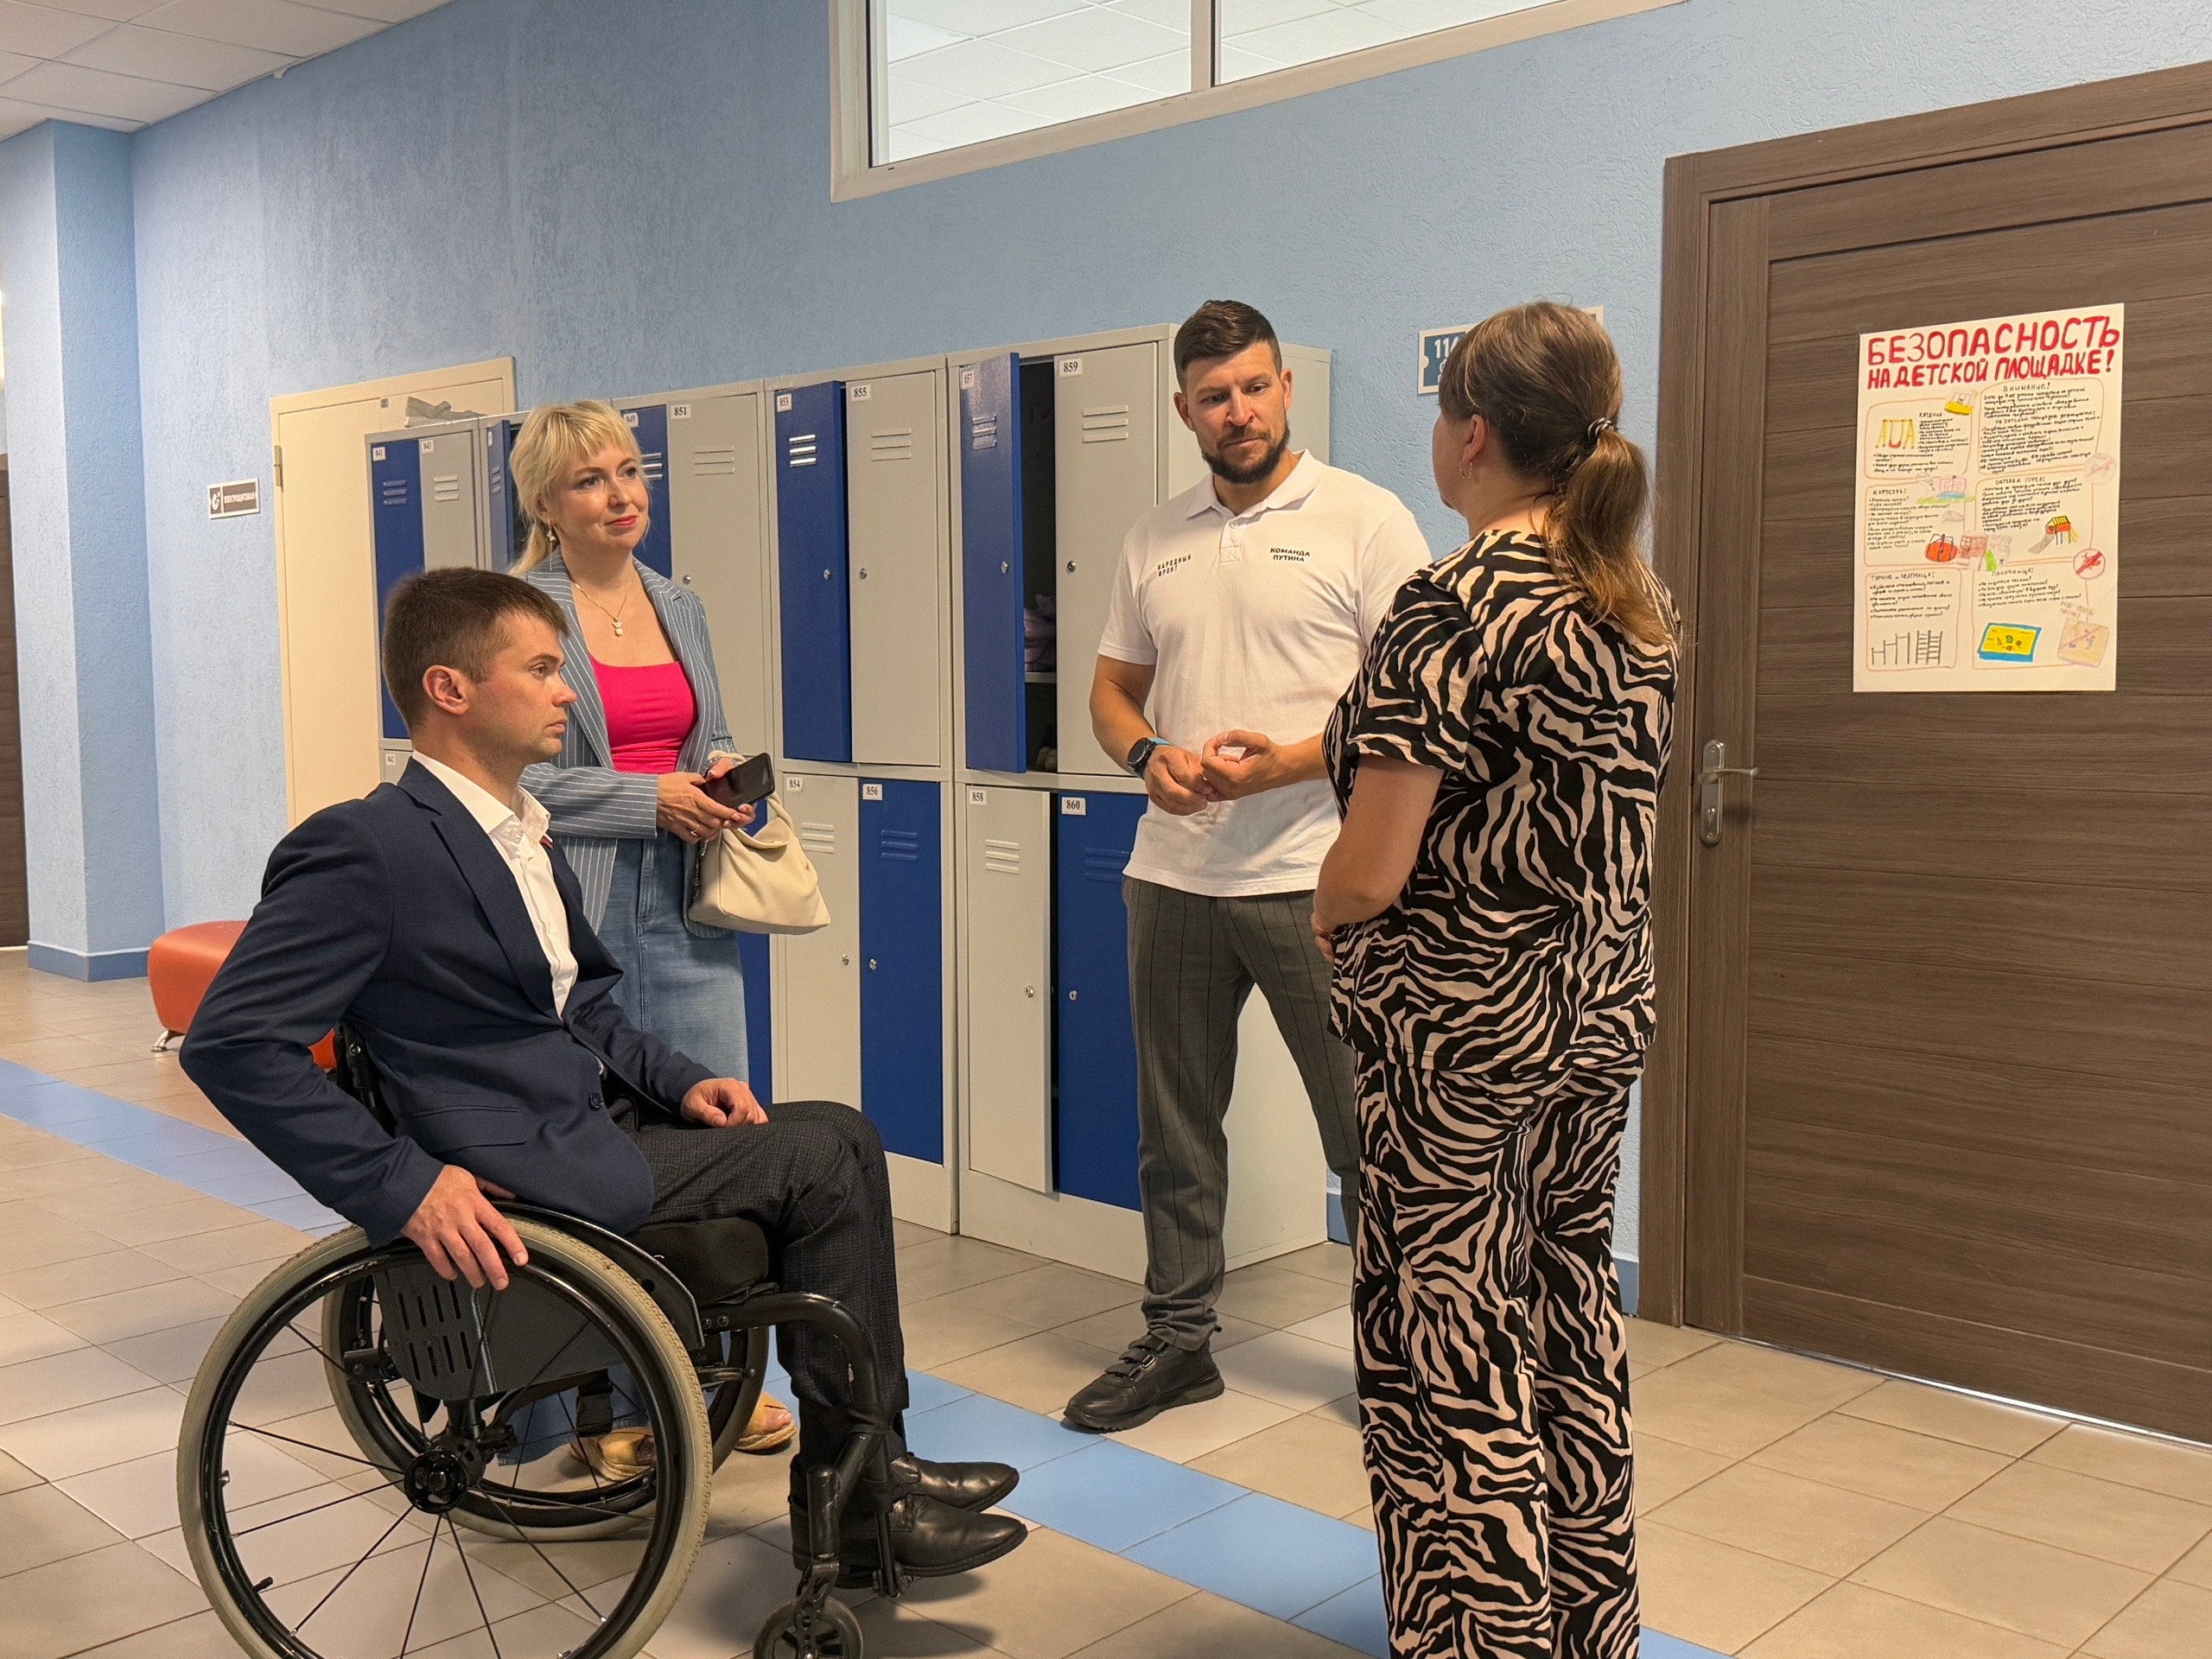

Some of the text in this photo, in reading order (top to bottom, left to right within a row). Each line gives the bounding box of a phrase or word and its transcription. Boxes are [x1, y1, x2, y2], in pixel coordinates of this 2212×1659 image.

[1867, 315, 2120, 366] БЕЗОПАСНОСТЬ
[1063, 361, 1078, 372] 859
[1867, 348, 2114, 390] НА ДЕТСКОЙ ПЛОЩАДКЕ!
[963, 373, 972, 384] 857
[854, 387, 868, 397] 855
[779, 397, 789, 406] 853
[674, 407, 687, 416] 851
[1270, 547, 1311, 556] КОМАНДА
[789, 779, 800, 788] 854
[866, 786, 878, 795] 856
[972, 792, 983, 802] 858
[1066, 800, 1080, 810] 860
